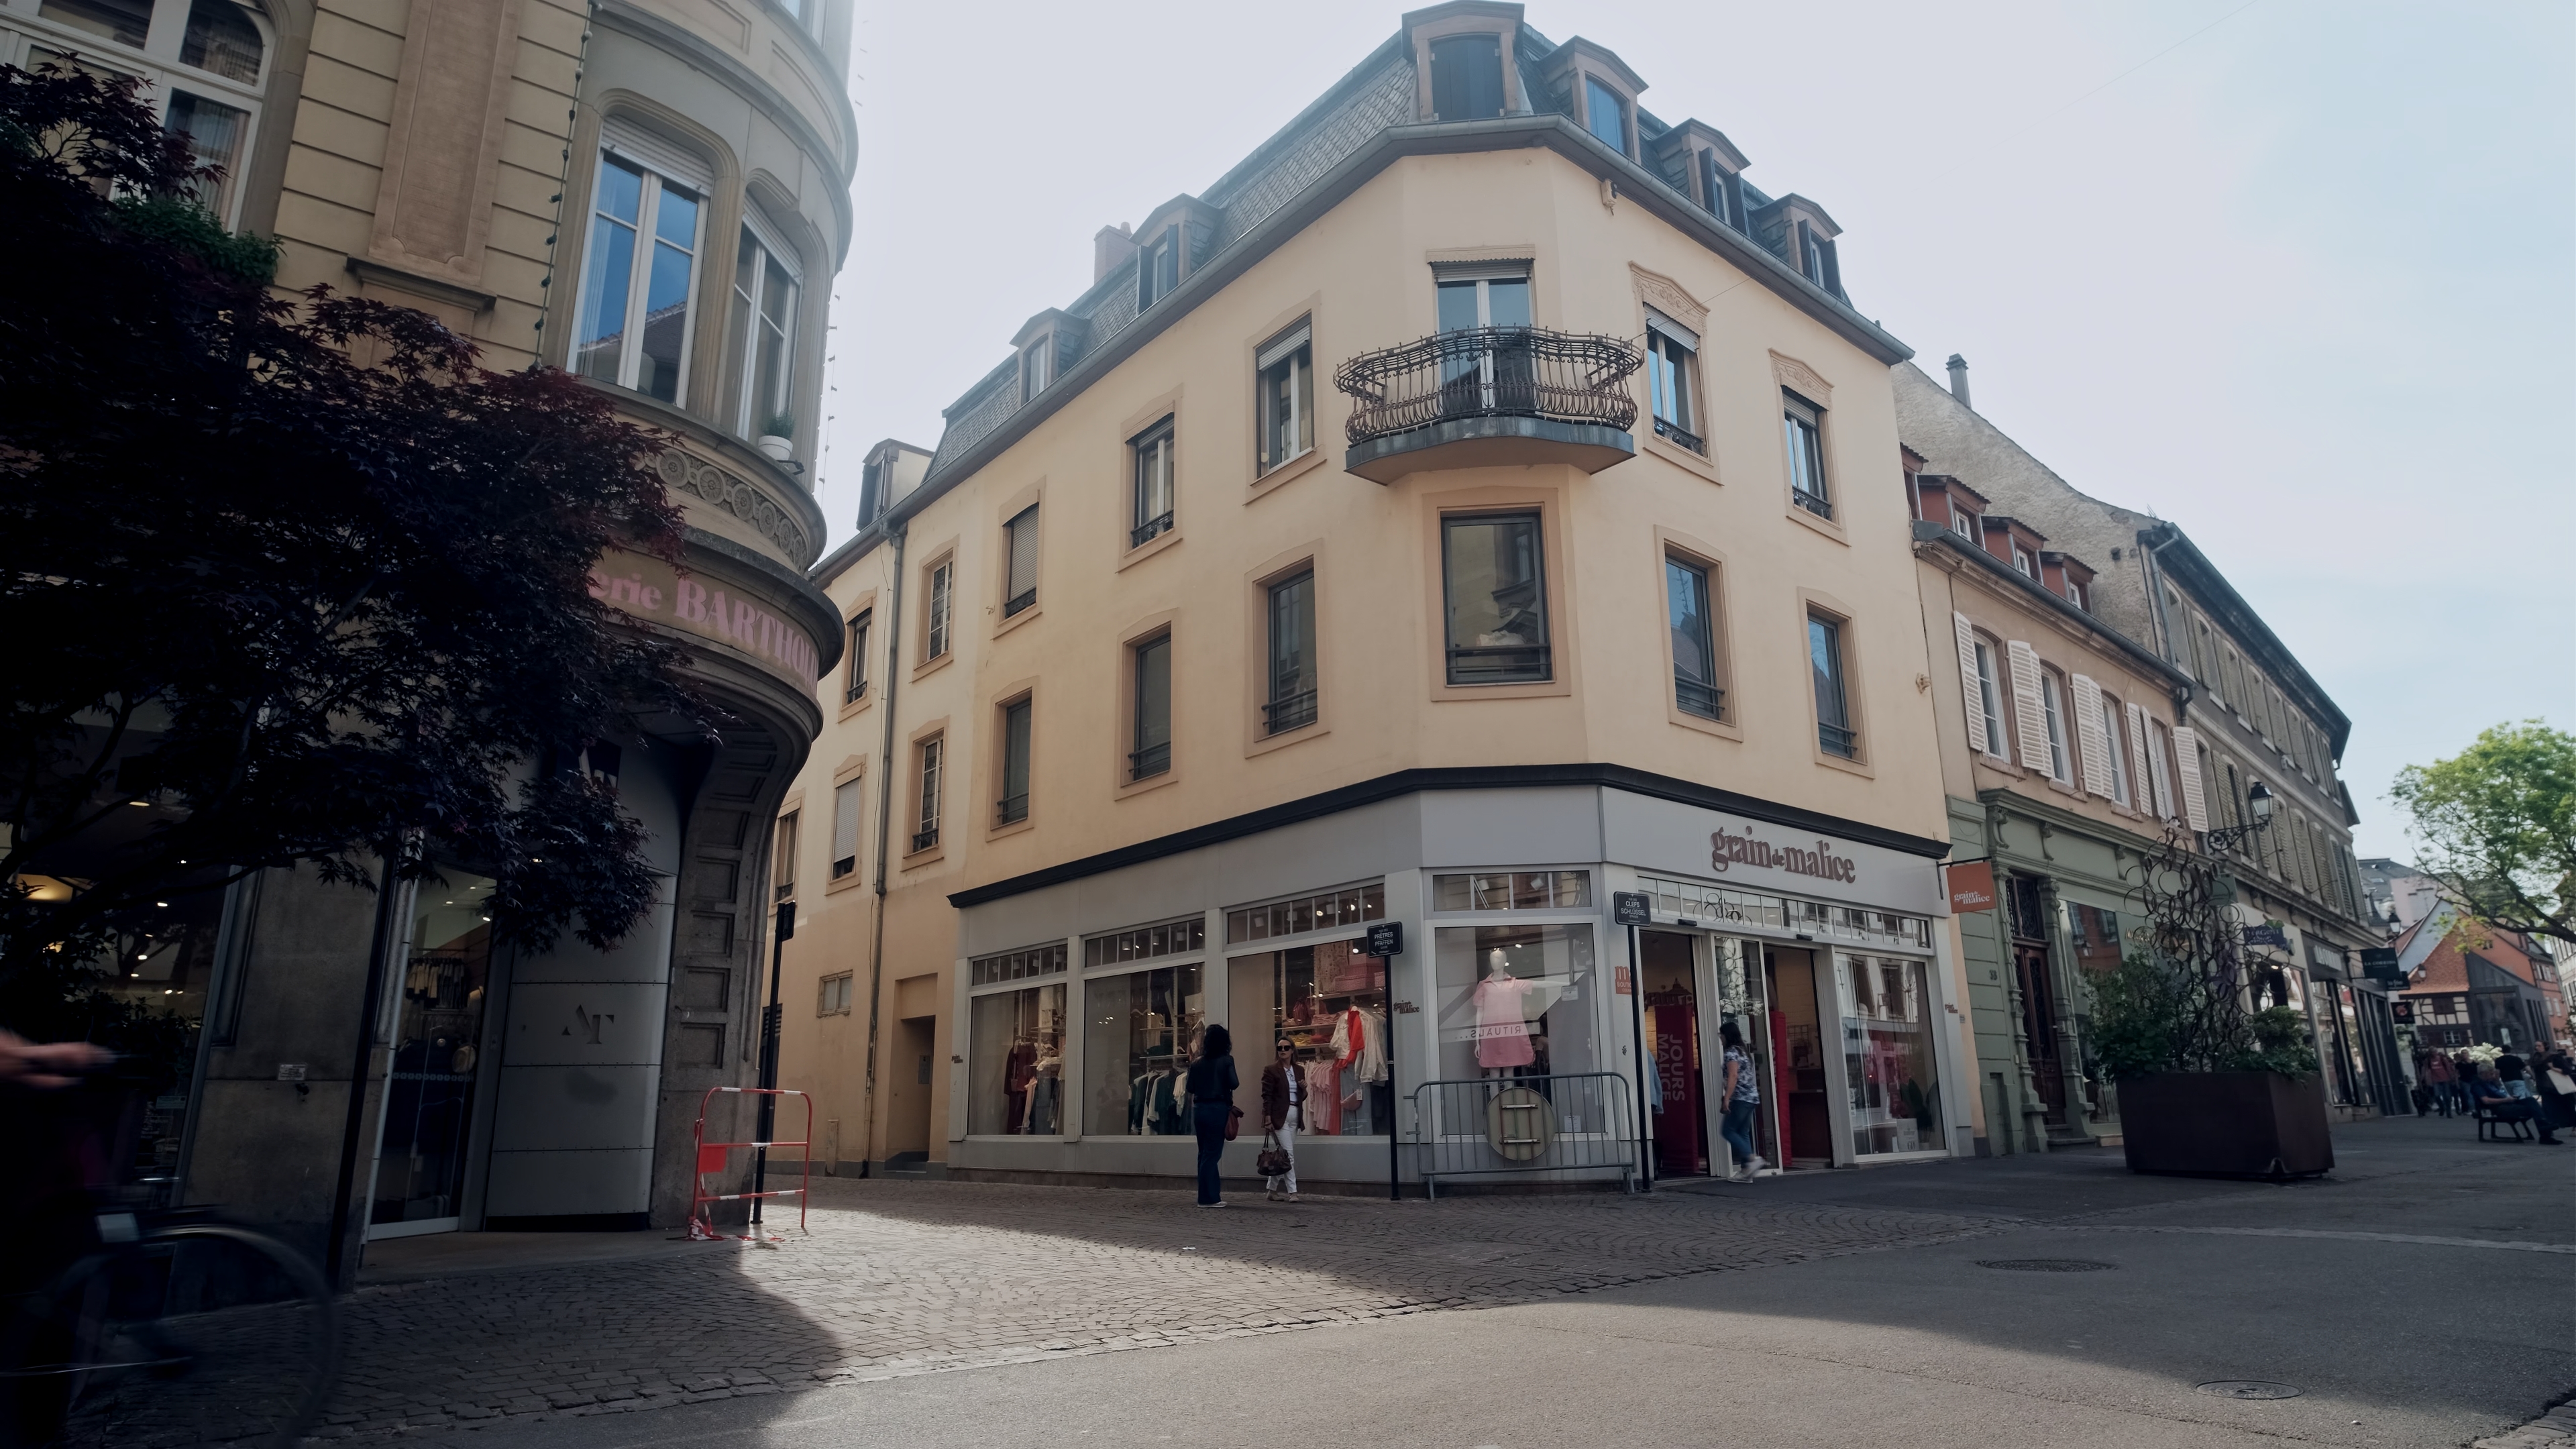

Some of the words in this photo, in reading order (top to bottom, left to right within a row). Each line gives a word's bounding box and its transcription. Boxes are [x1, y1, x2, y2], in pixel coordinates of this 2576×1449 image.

[1711, 826, 1773, 872] grain
[1772, 849, 1784, 866] de
[1782, 840, 1856, 883] malice
[1963, 894, 1990, 904] malice
[1375, 938, 1393, 947] PFAFFEN
[1658, 1034, 1672, 1100] MALICE
[1669, 1034, 1686, 1101] JOURS
